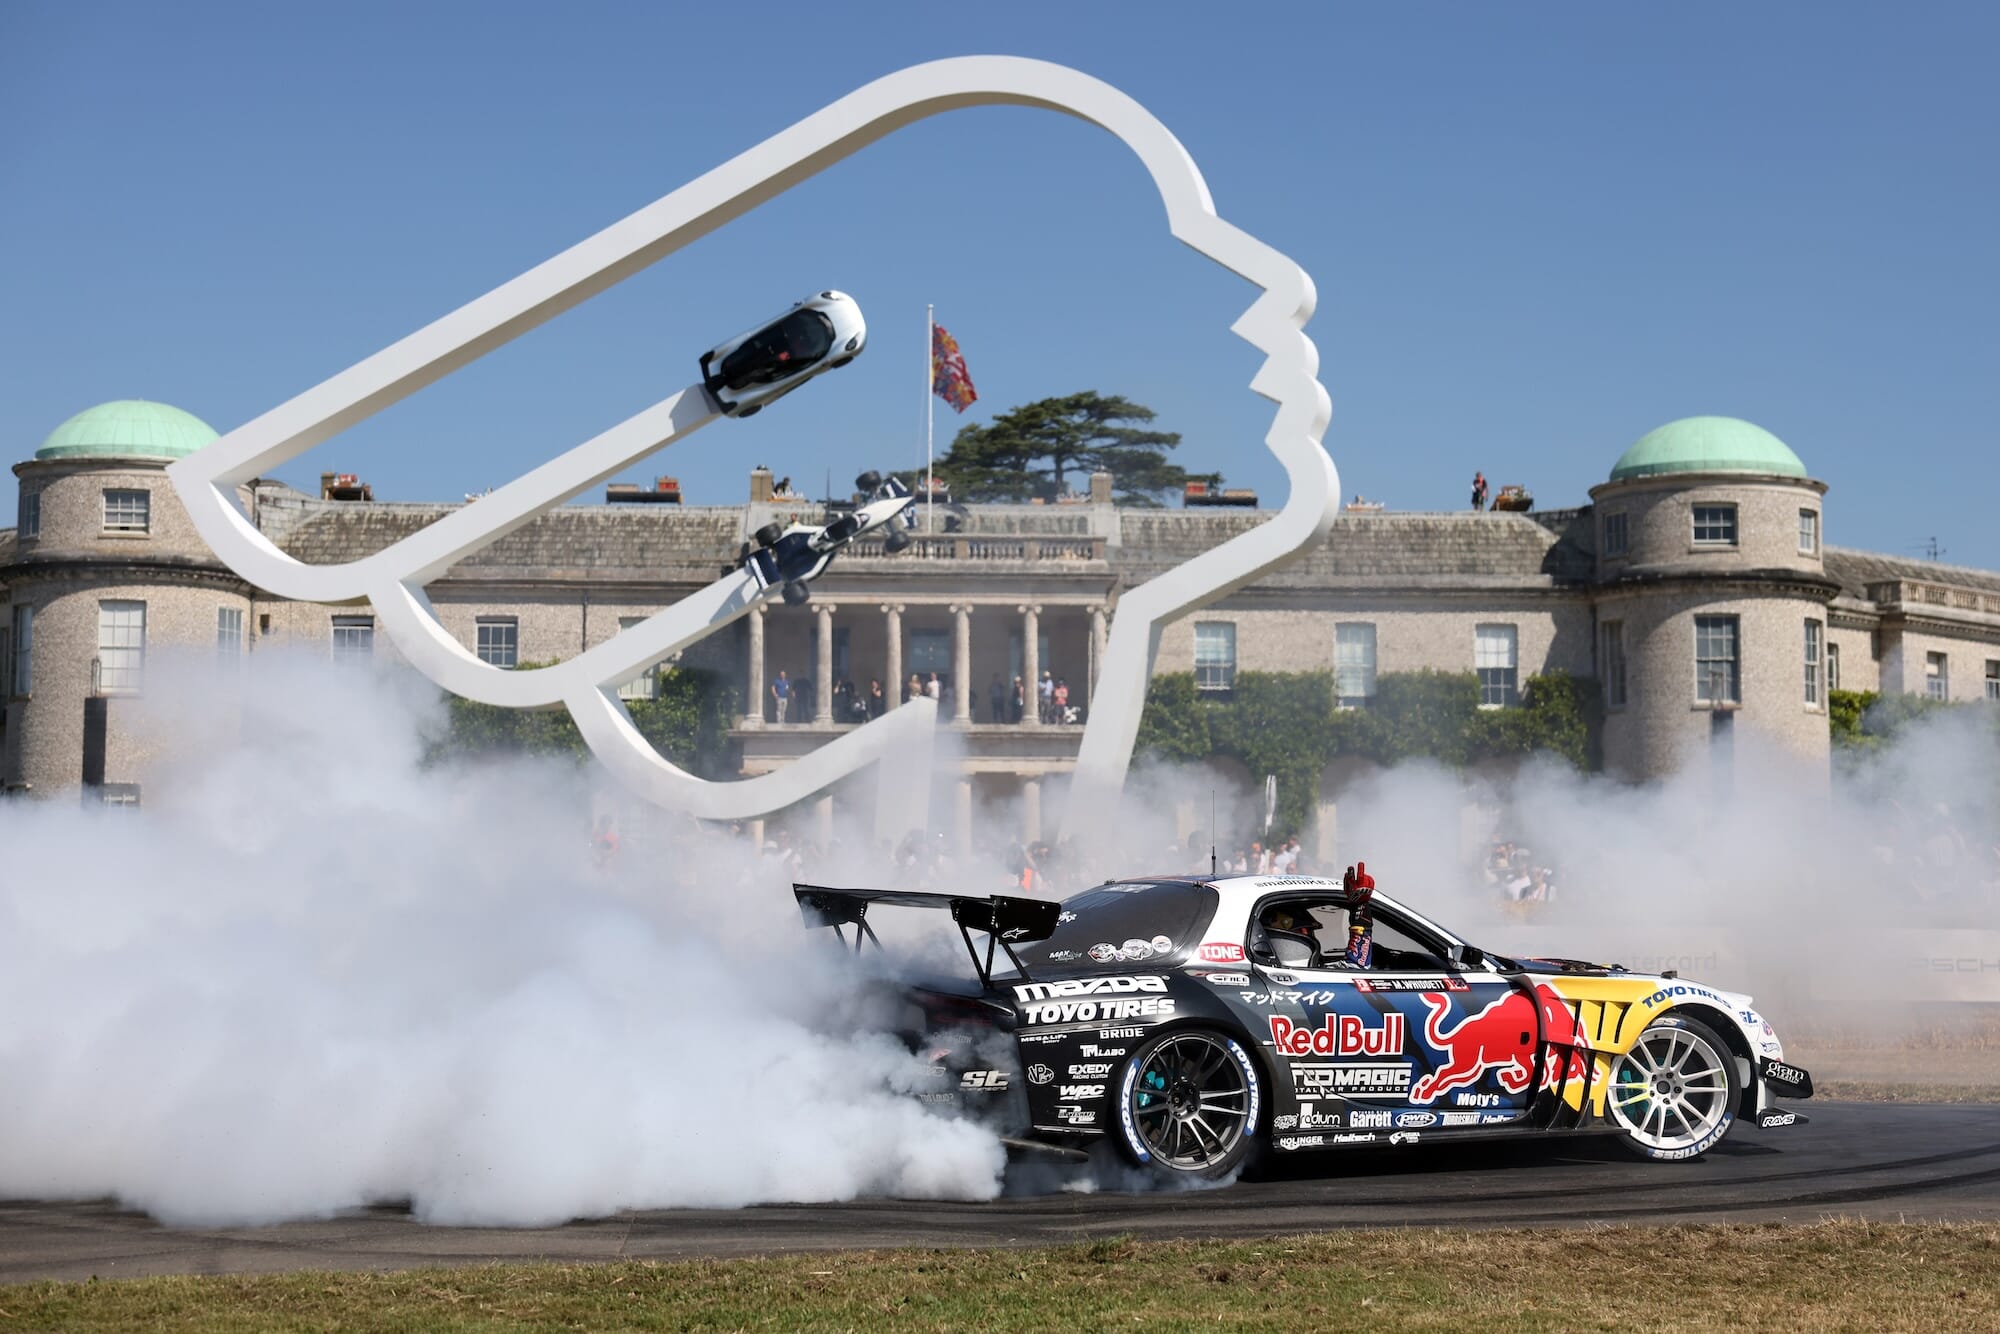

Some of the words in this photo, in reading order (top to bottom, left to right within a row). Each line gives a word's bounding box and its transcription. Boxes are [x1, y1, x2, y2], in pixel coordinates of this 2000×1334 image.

[1203, 947, 1241, 959] TONE
[1240, 990, 1335, 1005] マッドマイク
[1642, 986, 1686, 1008] TOYO
[1686, 987, 1733, 1010] TIRES
[1025, 1002, 1097, 1024] TOYO
[1099, 999, 1175, 1019] TIRES
[1099, 1028, 1144, 1040] BRIDE
[1268, 1014, 1336, 1056] Red
[1338, 1012, 1404, 1056] Bull
[1068, 1064, 1113, 1075] EXEDY
[1766, 1062, 1804, 1079] gram
[1230, 1042, 1257, 1084] TOYO
[1246, 1084, 1259, 1132] TIRES
[1457, 1093, 1499, 1107] Moty's
[1122, 1062, 1144, 1156] PROXES
[1350, 1110, 1392, 1127] Garrett
[1762, 1113, 1795, 1127] RAYS
[1280, 1136, 1324, 1146] HOLINGER
[1333, 1132, 1376, 1143] Haltech
[1698, 1117, 1731, 1154] TOYO
[1652, 1144, 1699, 1160] TIRES
